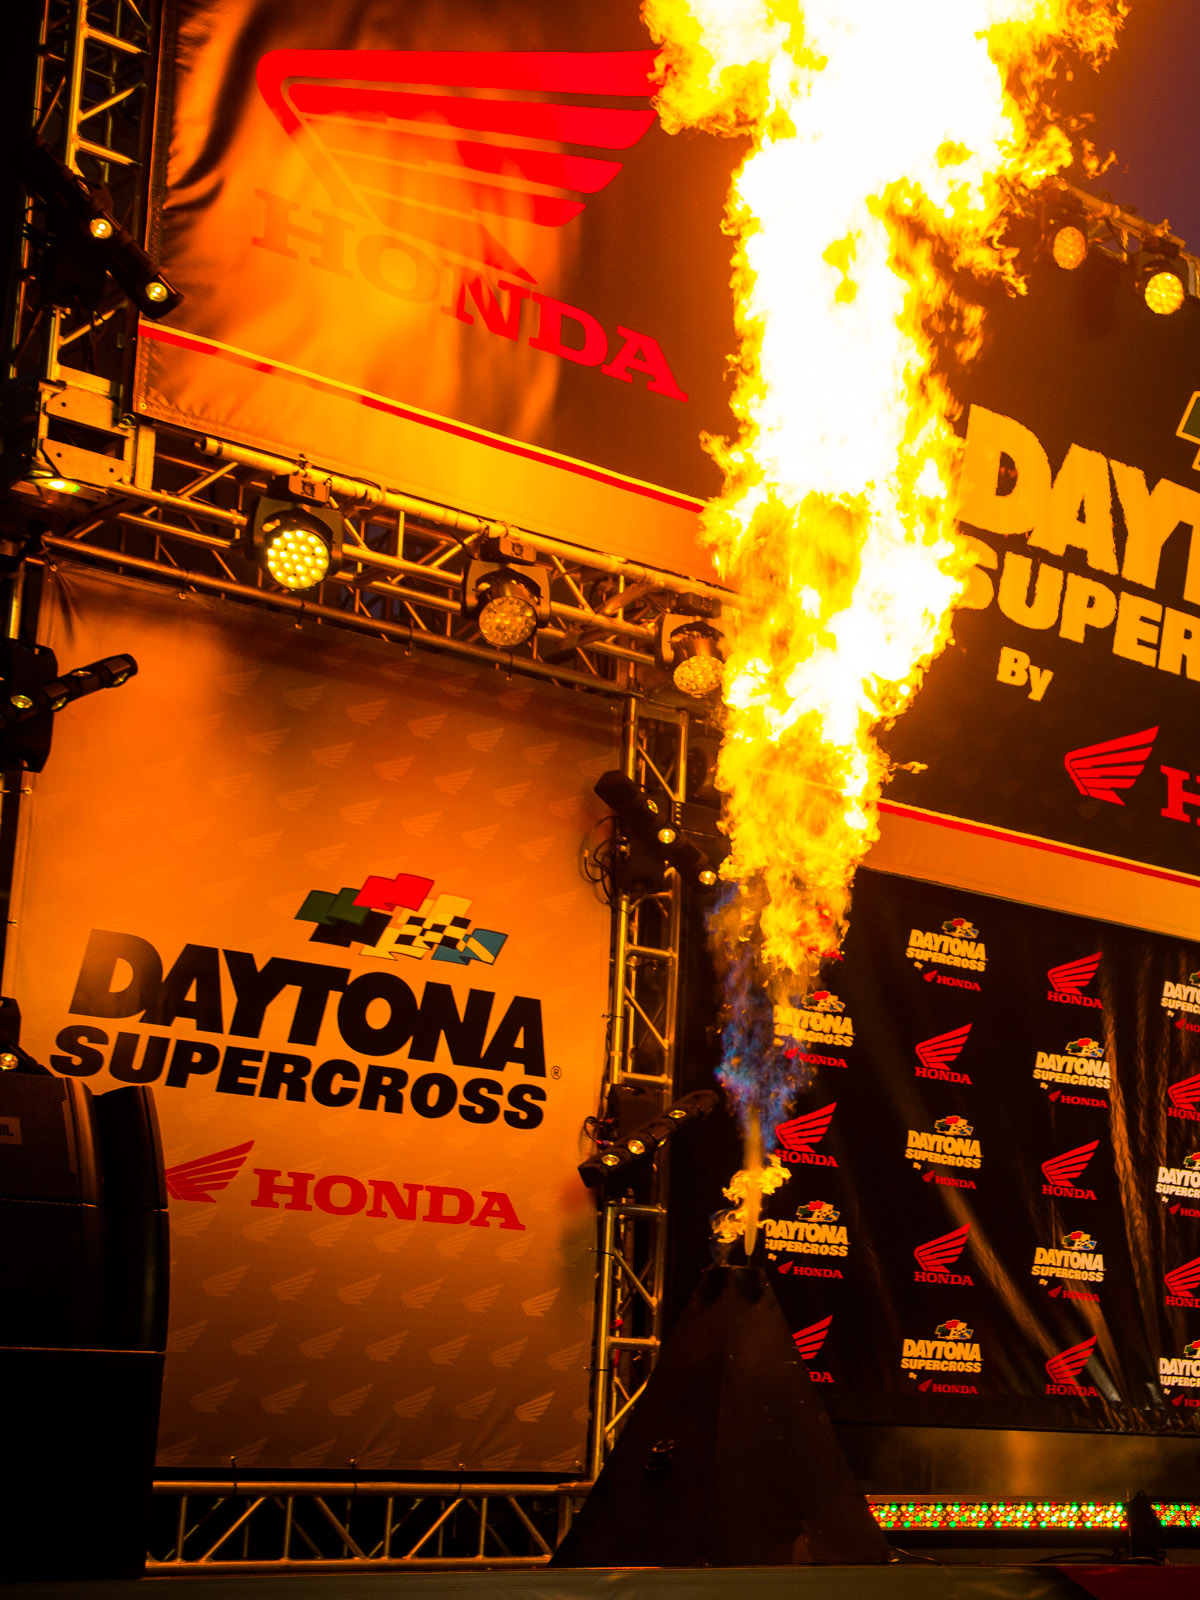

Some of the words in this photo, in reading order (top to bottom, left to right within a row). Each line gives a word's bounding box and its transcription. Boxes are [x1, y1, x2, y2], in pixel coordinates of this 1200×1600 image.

[252, 189, 689, 403] HONDA
[996, 646, 1054, 701] By
[909, 930, 986, 960] DAYTONA
[906, 947, 985, 972] SUPERCROSS
[936, 975, 981, 991] HONDA
[68, 928, 546, 1077] DAYTONA
[1048, 991, 1103, 1009] HONDA
[773, 1004, 854, 1035] TONA
[774, 1024, 853, 1048] CROSS
[1035, 1051, 1111, 1079] DAYTONA
[50, 1024, 546, 1130] SUPERCROSS
[915, 1067, 972, 1085] HONDA
[1033, 1068, 1110, 1089] SUPERCROSS
[1061, 1095, 1108, 1109] HONDA
[907, 1130, 981, 1158] DAYTONA
[774, 1149, 839, 1168] HONDA
[905, 1148, 981, 1169] SUPERCROSS
[935, 1175, 977, 1189] HONDA
[1042, 1185, 1097, 1200] HONDA
[251, 1168, 525, 1230] HONDA
[765, 1219, 848, 1245] DAYTONA
[1033, 1247, 1104, 1271] DAYTONA
[794, 1266, 844, 1279] HONDA
[914, 1271, 974, 1286] HONDA
[1031, 1265, 1104, 1282] SUPERCROSS
[902, 1339, 982, 1361] DAYTONA
[901, 1357, 981, 1373] SUPERCROSS
[932, 1382, 978, 1395] HONDA
[1045, 1384, 1098, 1397] HONDA
